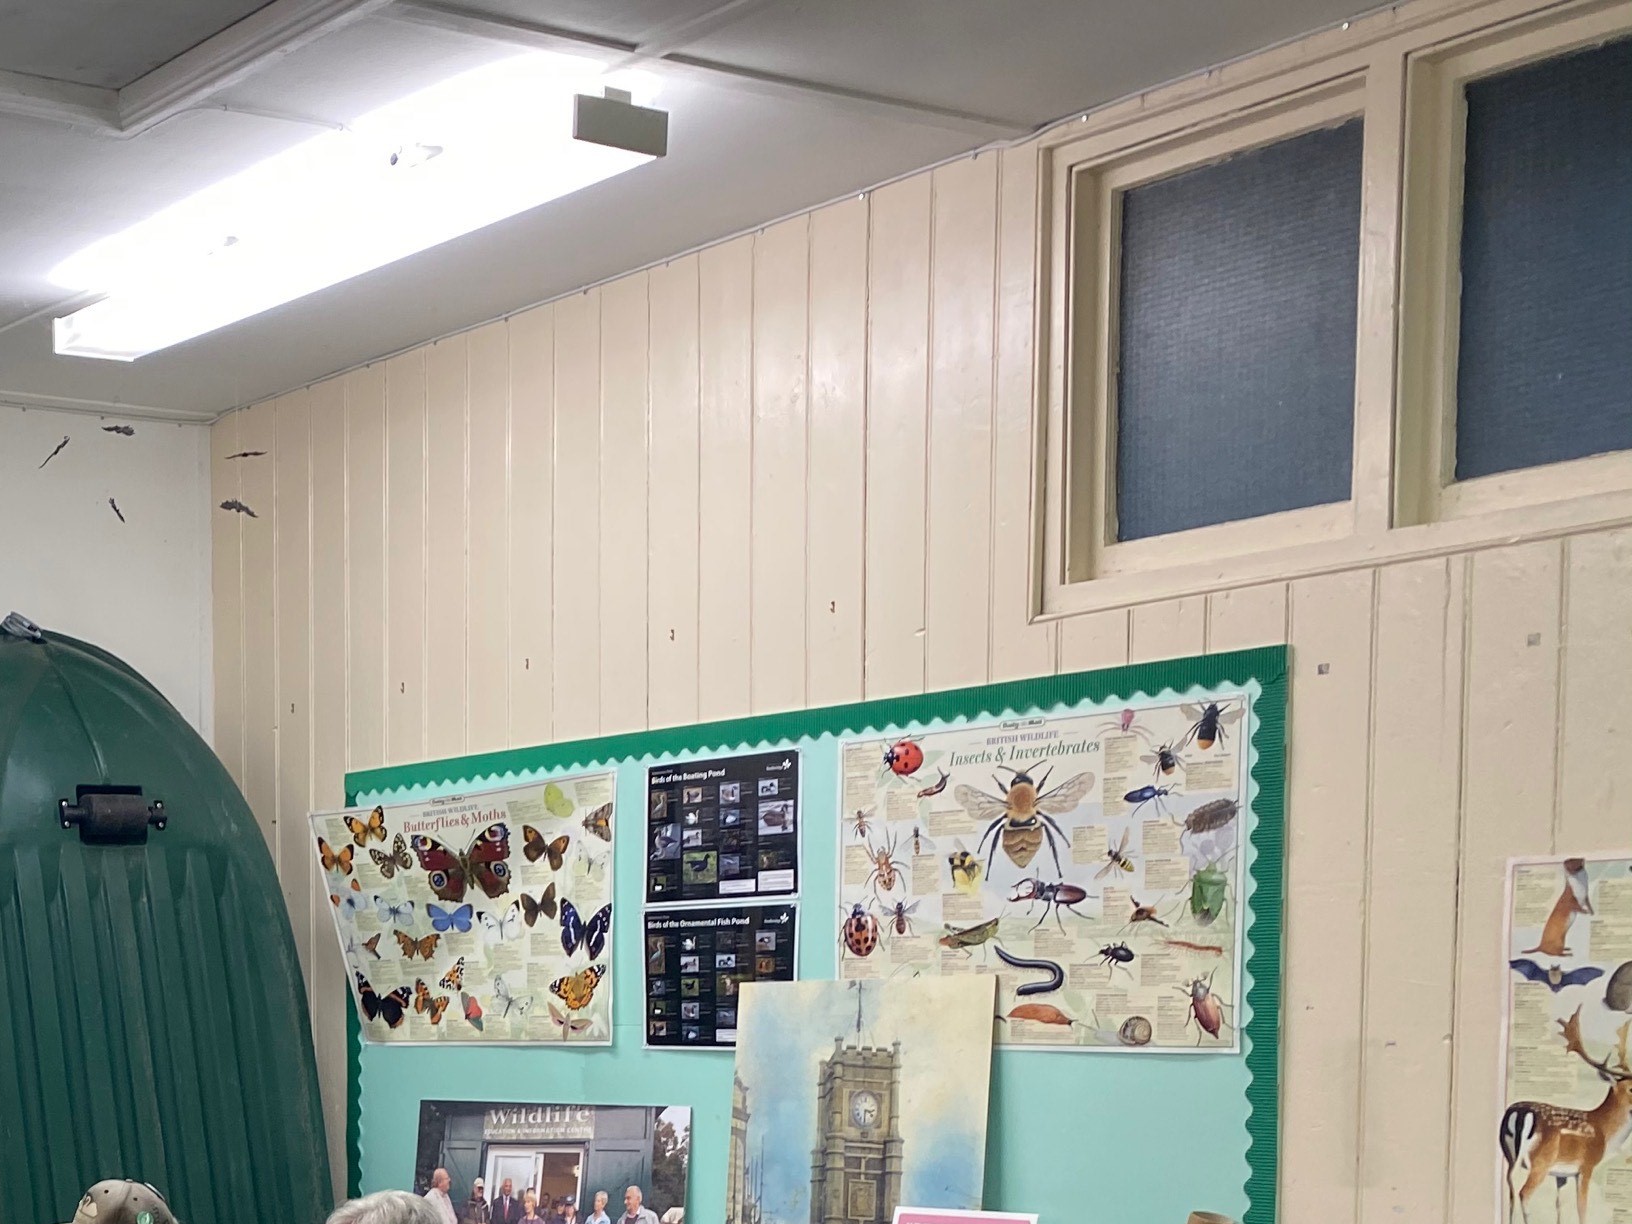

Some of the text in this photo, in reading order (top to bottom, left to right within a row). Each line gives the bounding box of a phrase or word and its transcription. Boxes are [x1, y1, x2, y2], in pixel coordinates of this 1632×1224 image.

[986, 730, 1058, 745] BRITISH WILDLIFE
[950, 750, 992, 766] Insects
[995, 746, 1005, 764] &
[1009, 740, 1100, 760] Invertebrates
[403, 816, 460, 833] Butterflies
[460, 813, 470, 826] &
[471, 808, 507, 824] Moths
[490, 1105, 590, 1125] Wildlife
